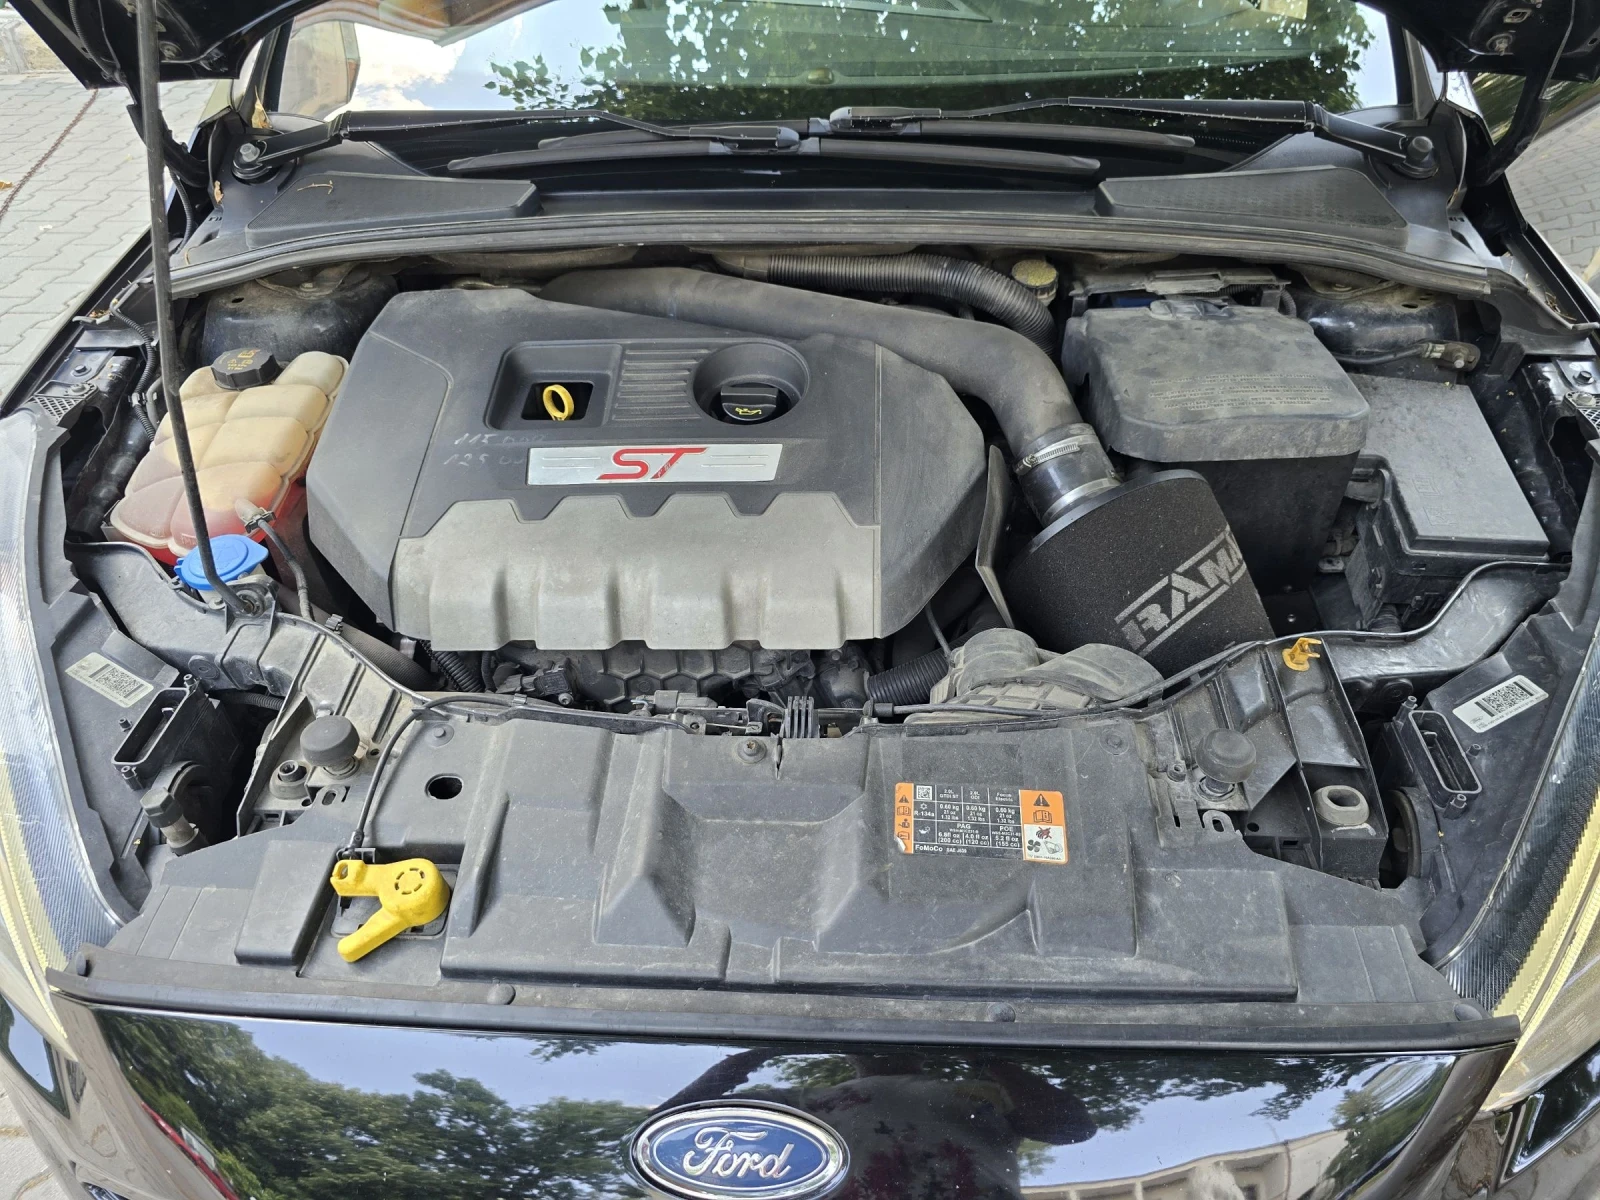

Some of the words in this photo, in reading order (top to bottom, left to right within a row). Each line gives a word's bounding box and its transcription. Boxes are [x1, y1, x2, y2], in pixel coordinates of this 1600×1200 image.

[596, 446, 707, 480] ST
[978, 805, 986, 813] kg
[1008, 807, 1016, 815] kg
[914, 844, 943, 852] FoMoCo
[682, 1126, 795, 1179] Ford
